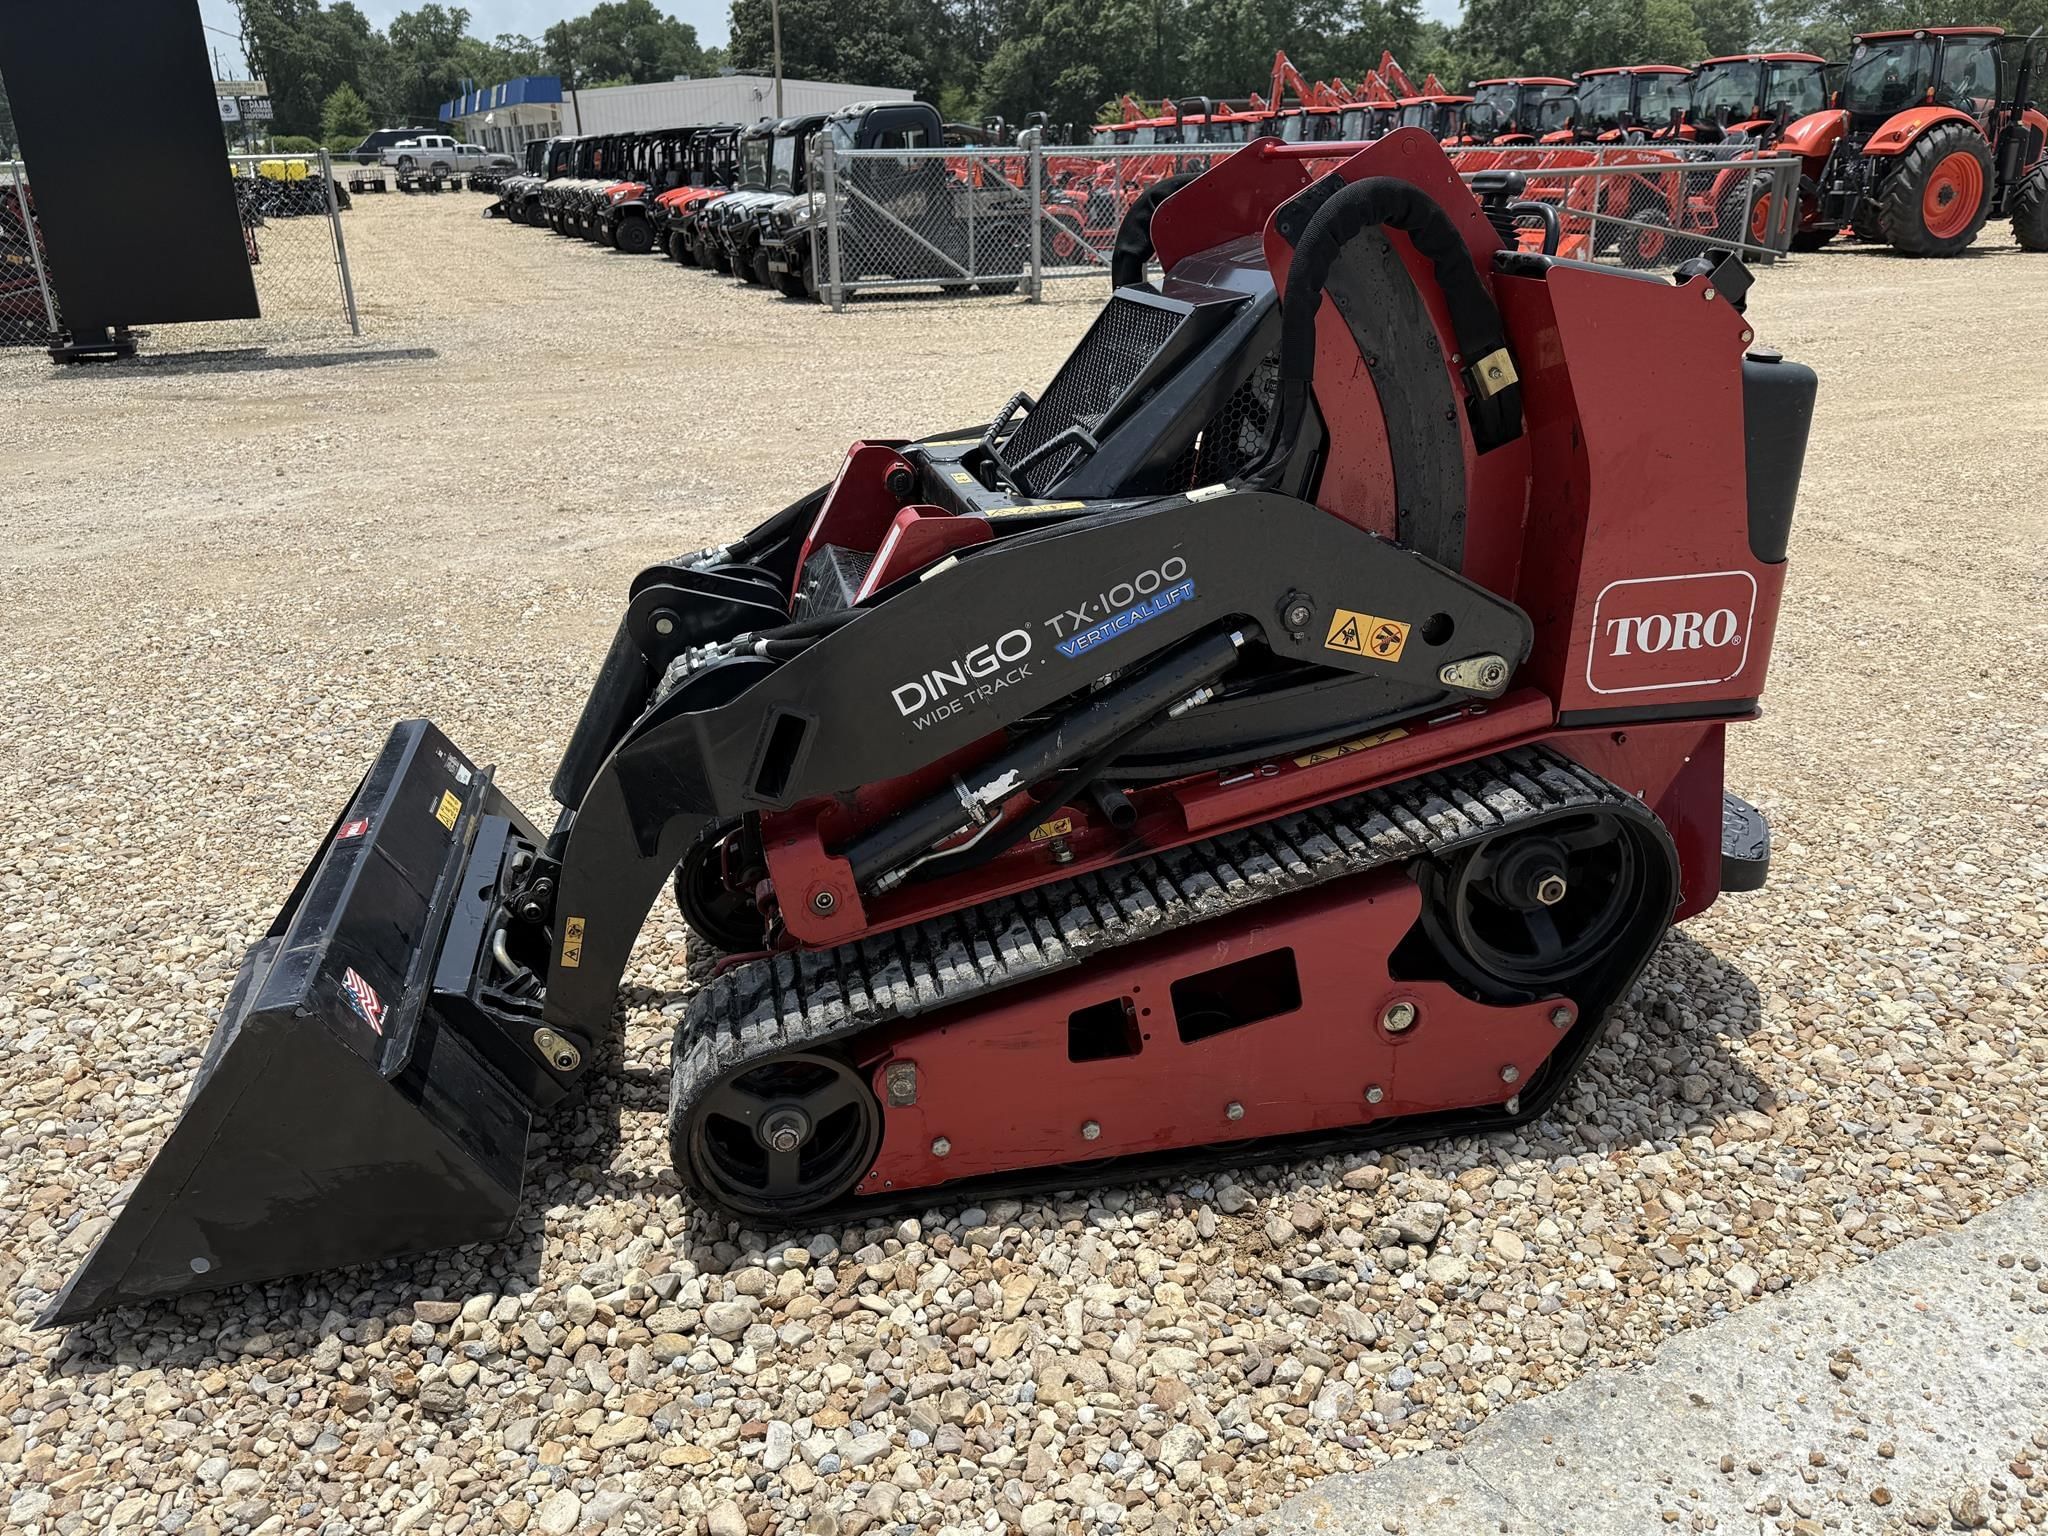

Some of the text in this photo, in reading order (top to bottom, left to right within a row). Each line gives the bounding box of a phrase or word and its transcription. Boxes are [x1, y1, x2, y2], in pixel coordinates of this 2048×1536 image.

[1059, 583, 1192, 655] VERTICAL LIFT
[1606, 608, 1739, 657] TORO
[891, 628, 1033, 717] DINGO
[912, 663, 1033, 731] WIDE TRACK
